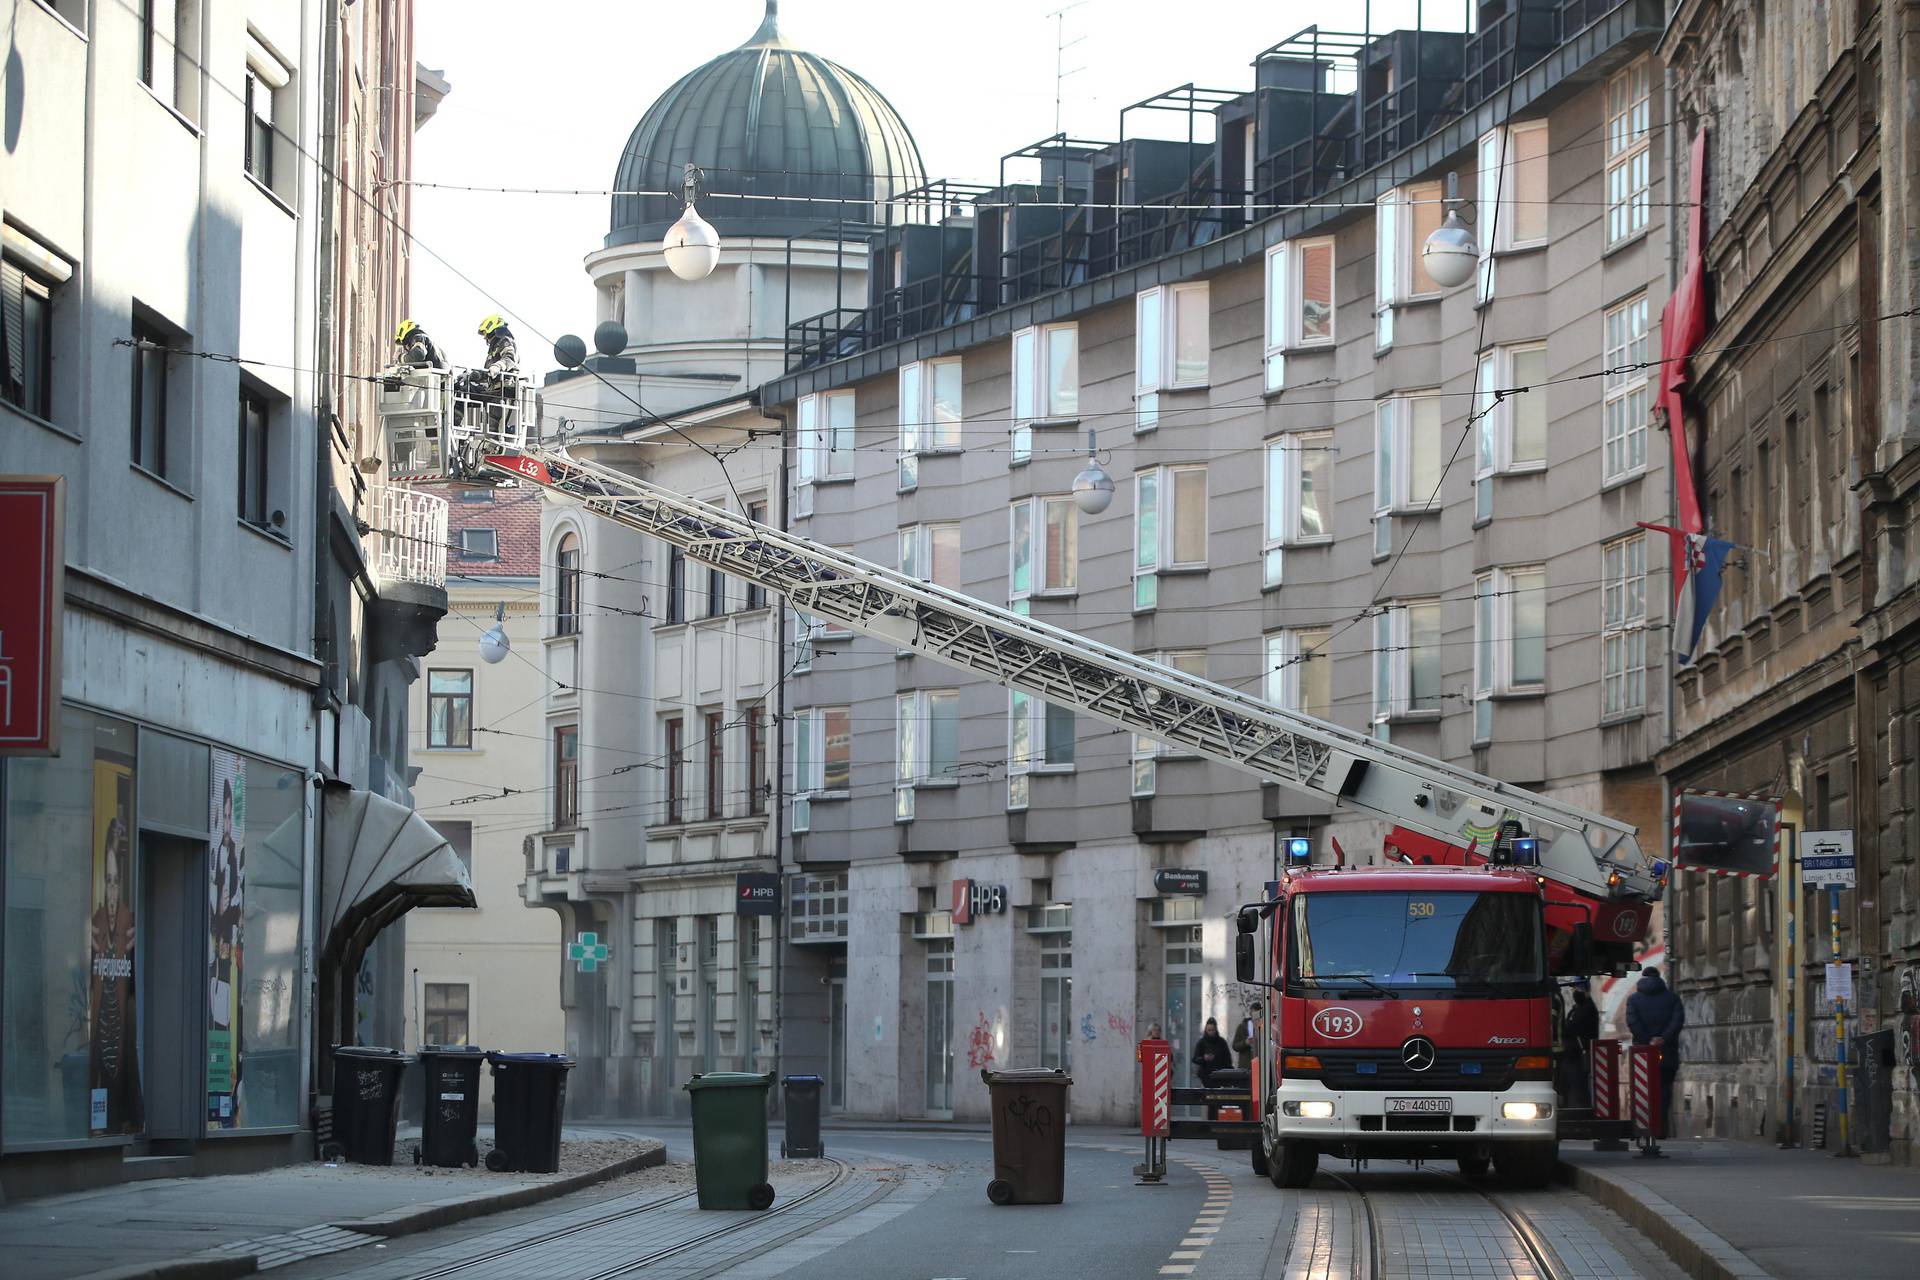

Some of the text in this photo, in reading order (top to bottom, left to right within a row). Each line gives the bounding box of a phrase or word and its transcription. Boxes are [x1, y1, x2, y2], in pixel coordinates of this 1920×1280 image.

[518, 458, 539, 477] L32
[1164, 872, 1199, 881] Bankomat
[753, 887, 774, 897] HPB
[970, 885, 1001, 914] HPB
[1409, 902, 1435, 917] 530
[1323, 1016, 1354, 1033] 193
[1393, 1100, 1406, 1111] ZG
